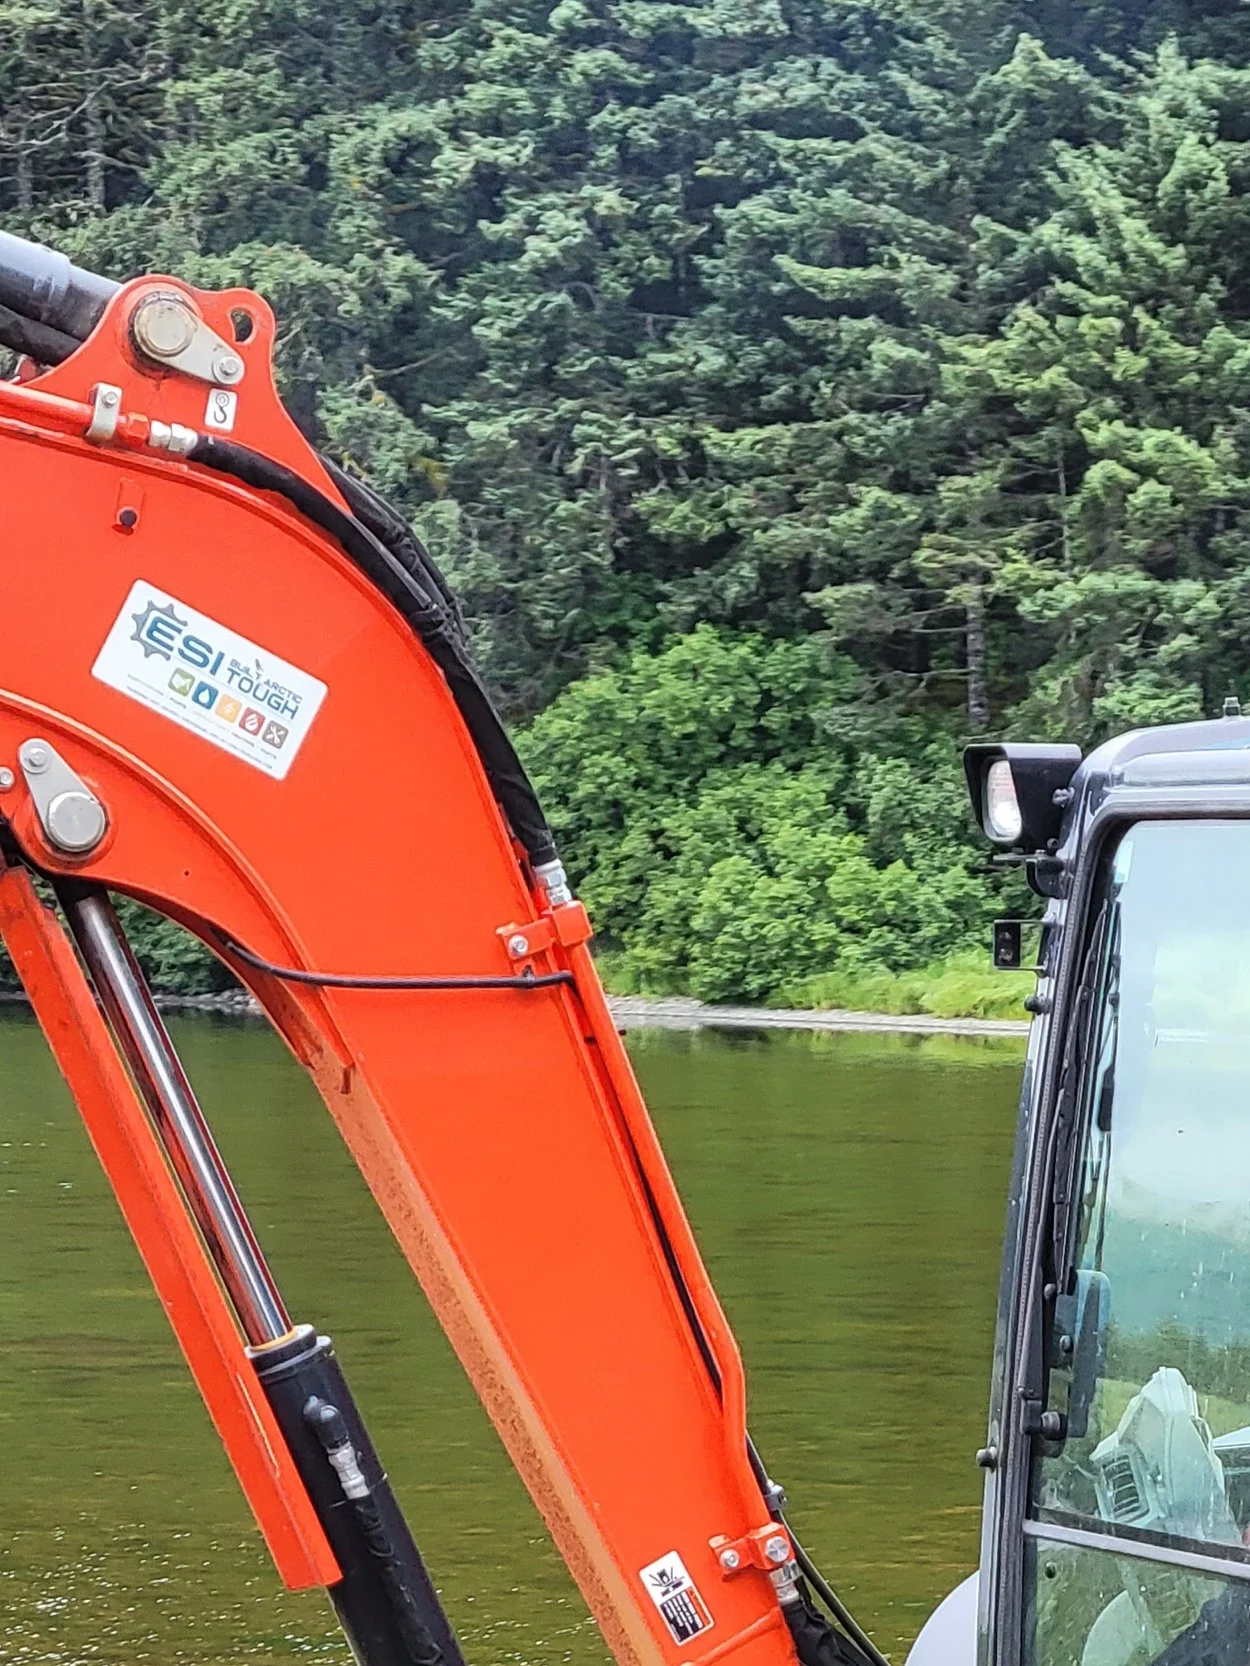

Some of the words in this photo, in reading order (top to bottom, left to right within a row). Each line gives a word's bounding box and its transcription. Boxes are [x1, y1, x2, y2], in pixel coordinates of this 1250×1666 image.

[145, 616, 226, 677] ESI
[227, 667, 299, 720] TOUGH
[230, 658, 263, 681] BUILT
[263, 678, 303, 704] ARCTIC
